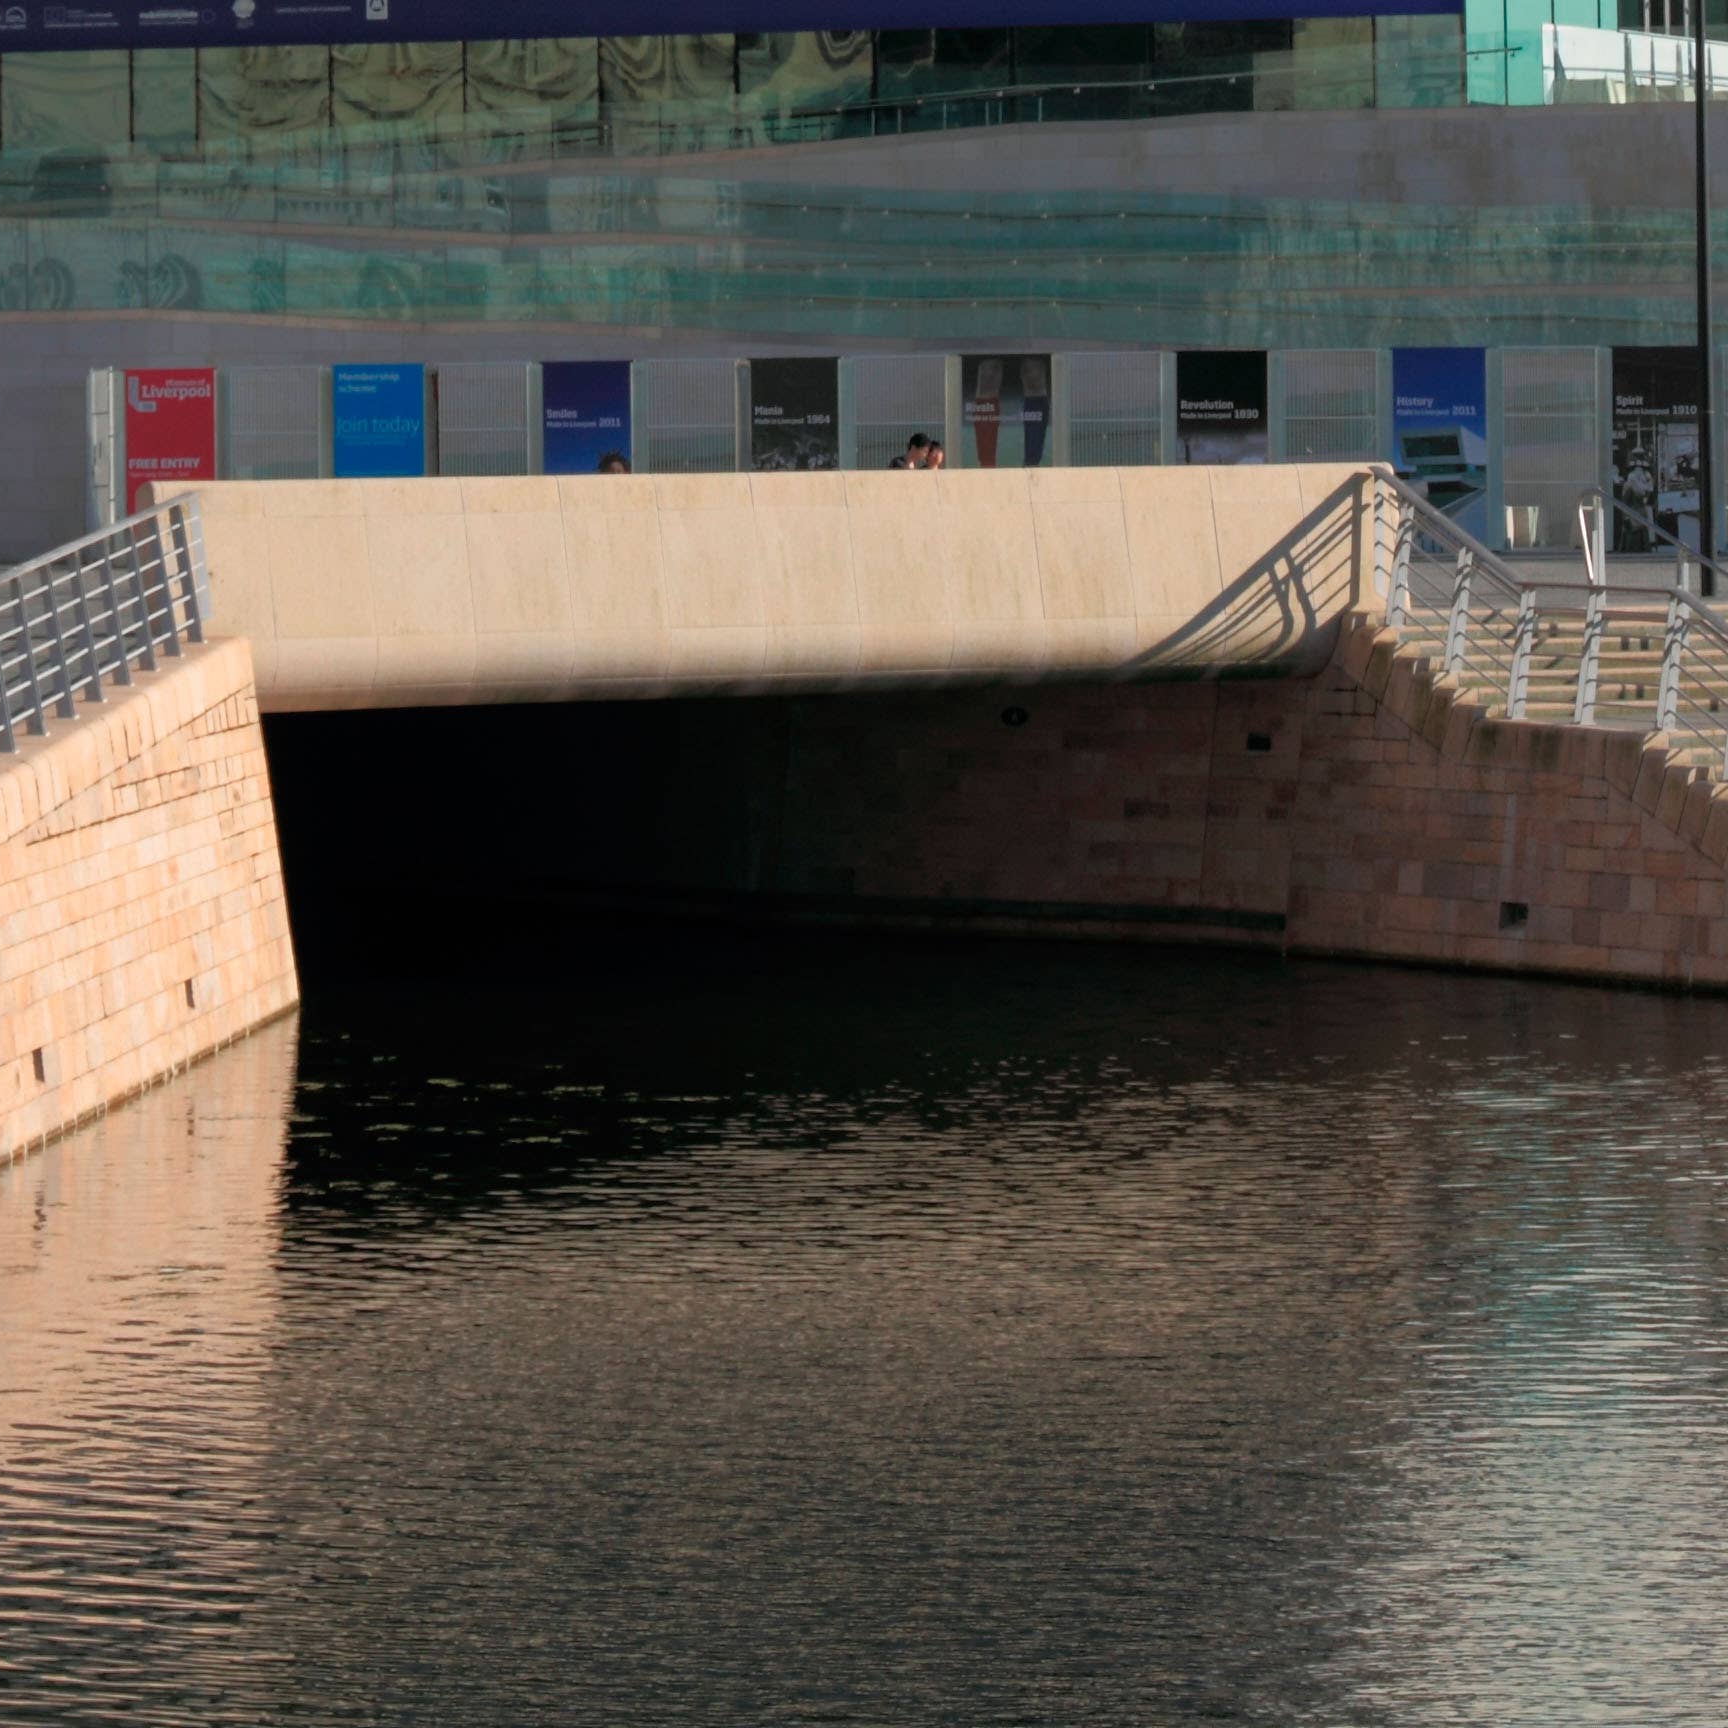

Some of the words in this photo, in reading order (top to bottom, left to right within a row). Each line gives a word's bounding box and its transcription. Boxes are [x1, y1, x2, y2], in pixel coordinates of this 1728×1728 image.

[338, 372, 400, 384] Membership
[142, 384, 211, 401] Liverpool
[1180, 399, 1234, 410] Revolution
[1396, 396, 1434, 408] History
[1615, 395, 1644, 407] Spirit
[754, 406, 783, 416] Mania
[965, 402, 995, 412] Rivals
[1452, 405, 1477, 416] 2011
[1672, 405, 1697, 415] 1910
[546, 409, 578, 419] Smiles
[372, 416, 420, 438] today
[598, 417, 621, 428] 2011
[128, 458, 158, 469] FREE
[160, 457, 200, 469] ENTRY
